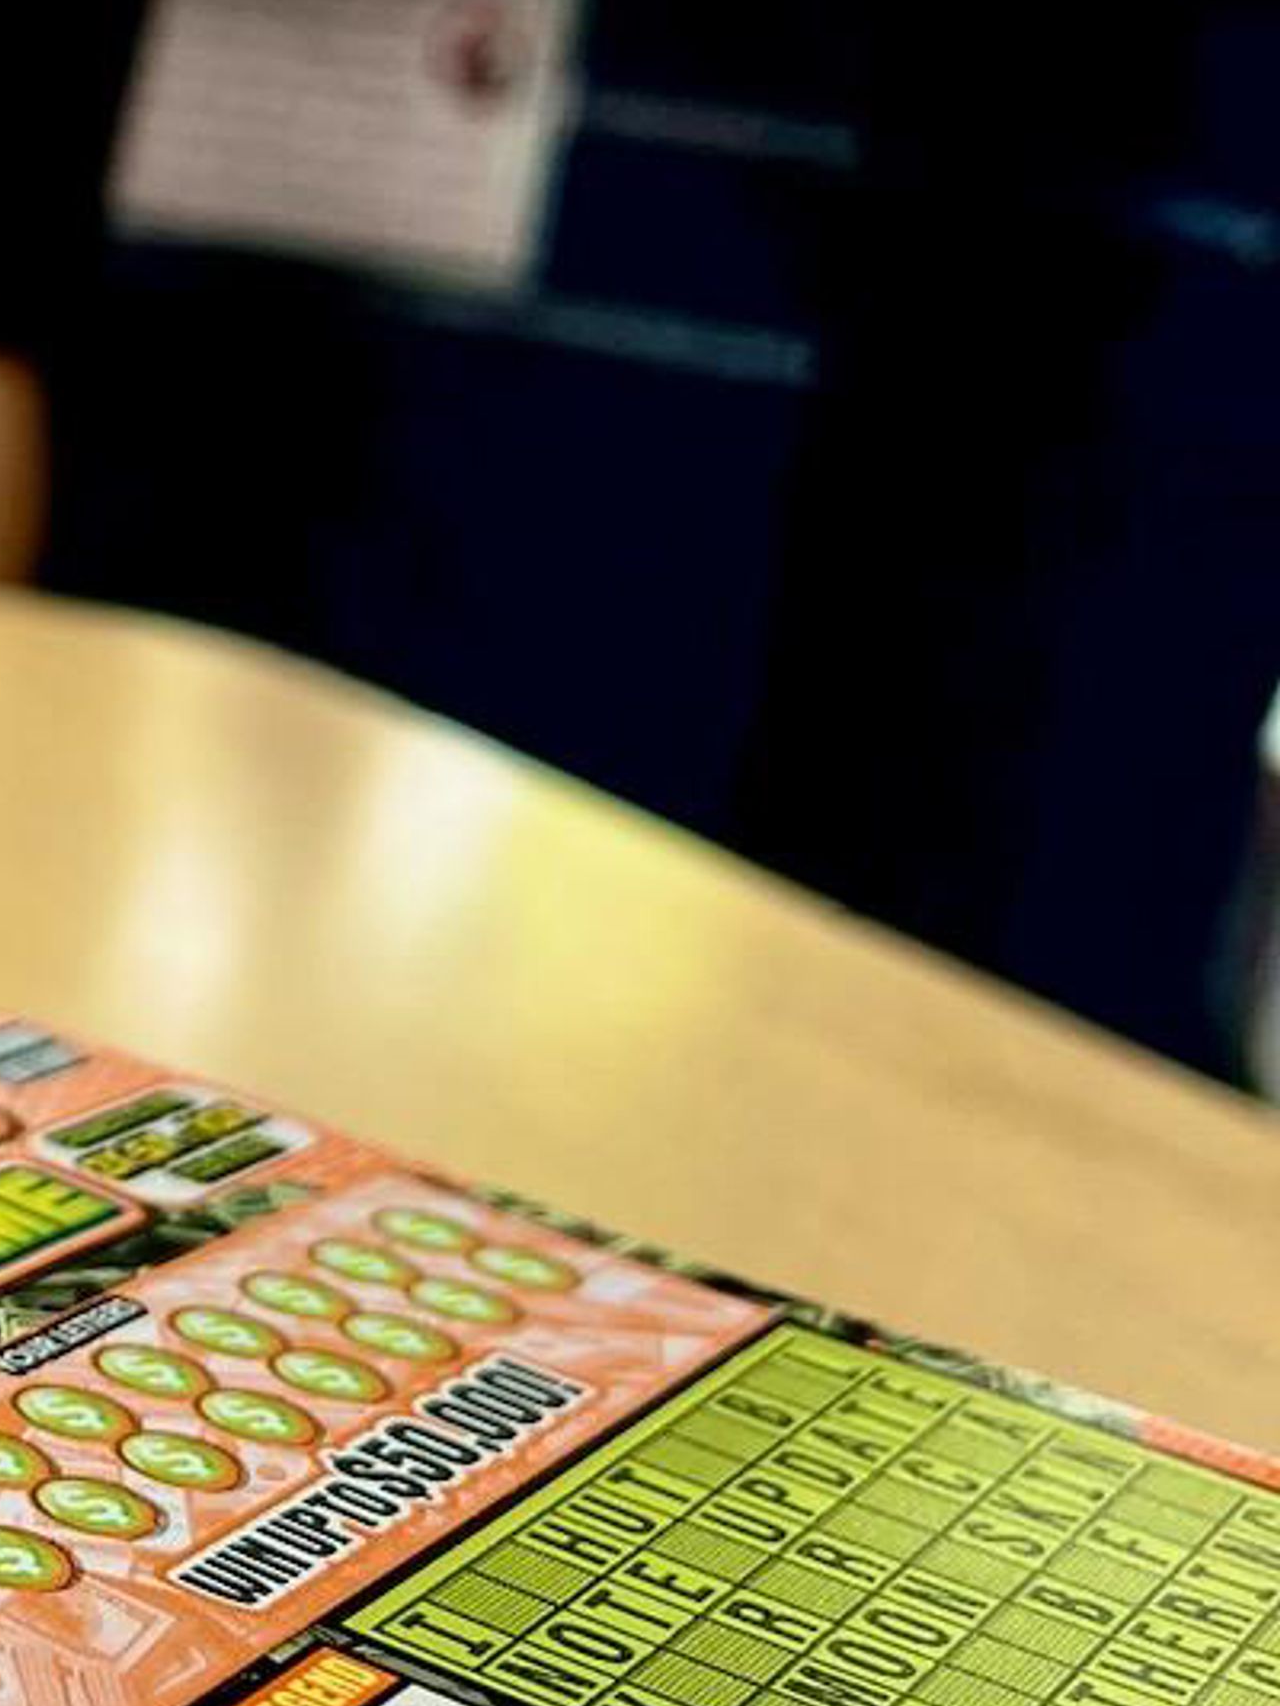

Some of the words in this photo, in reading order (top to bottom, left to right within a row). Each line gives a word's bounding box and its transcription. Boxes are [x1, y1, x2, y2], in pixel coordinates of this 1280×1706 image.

[325, 1351, 589, 1508] $50,000!
[252, 1503, 360, 1561] UP
[300, 1476, 404, 1533] TO
[497, 1559, 716, 1701] NOTE
[699, 1377, 946, 1546] UPDATE
[528, 1463, 691, 1568] HUT
[962, 1445, 1137, 1558] SKIN
[176, 1532, 312, 1610] WIN
[721, 1596, 822, 1647] R
[795, 1527, 887, 1586] R
